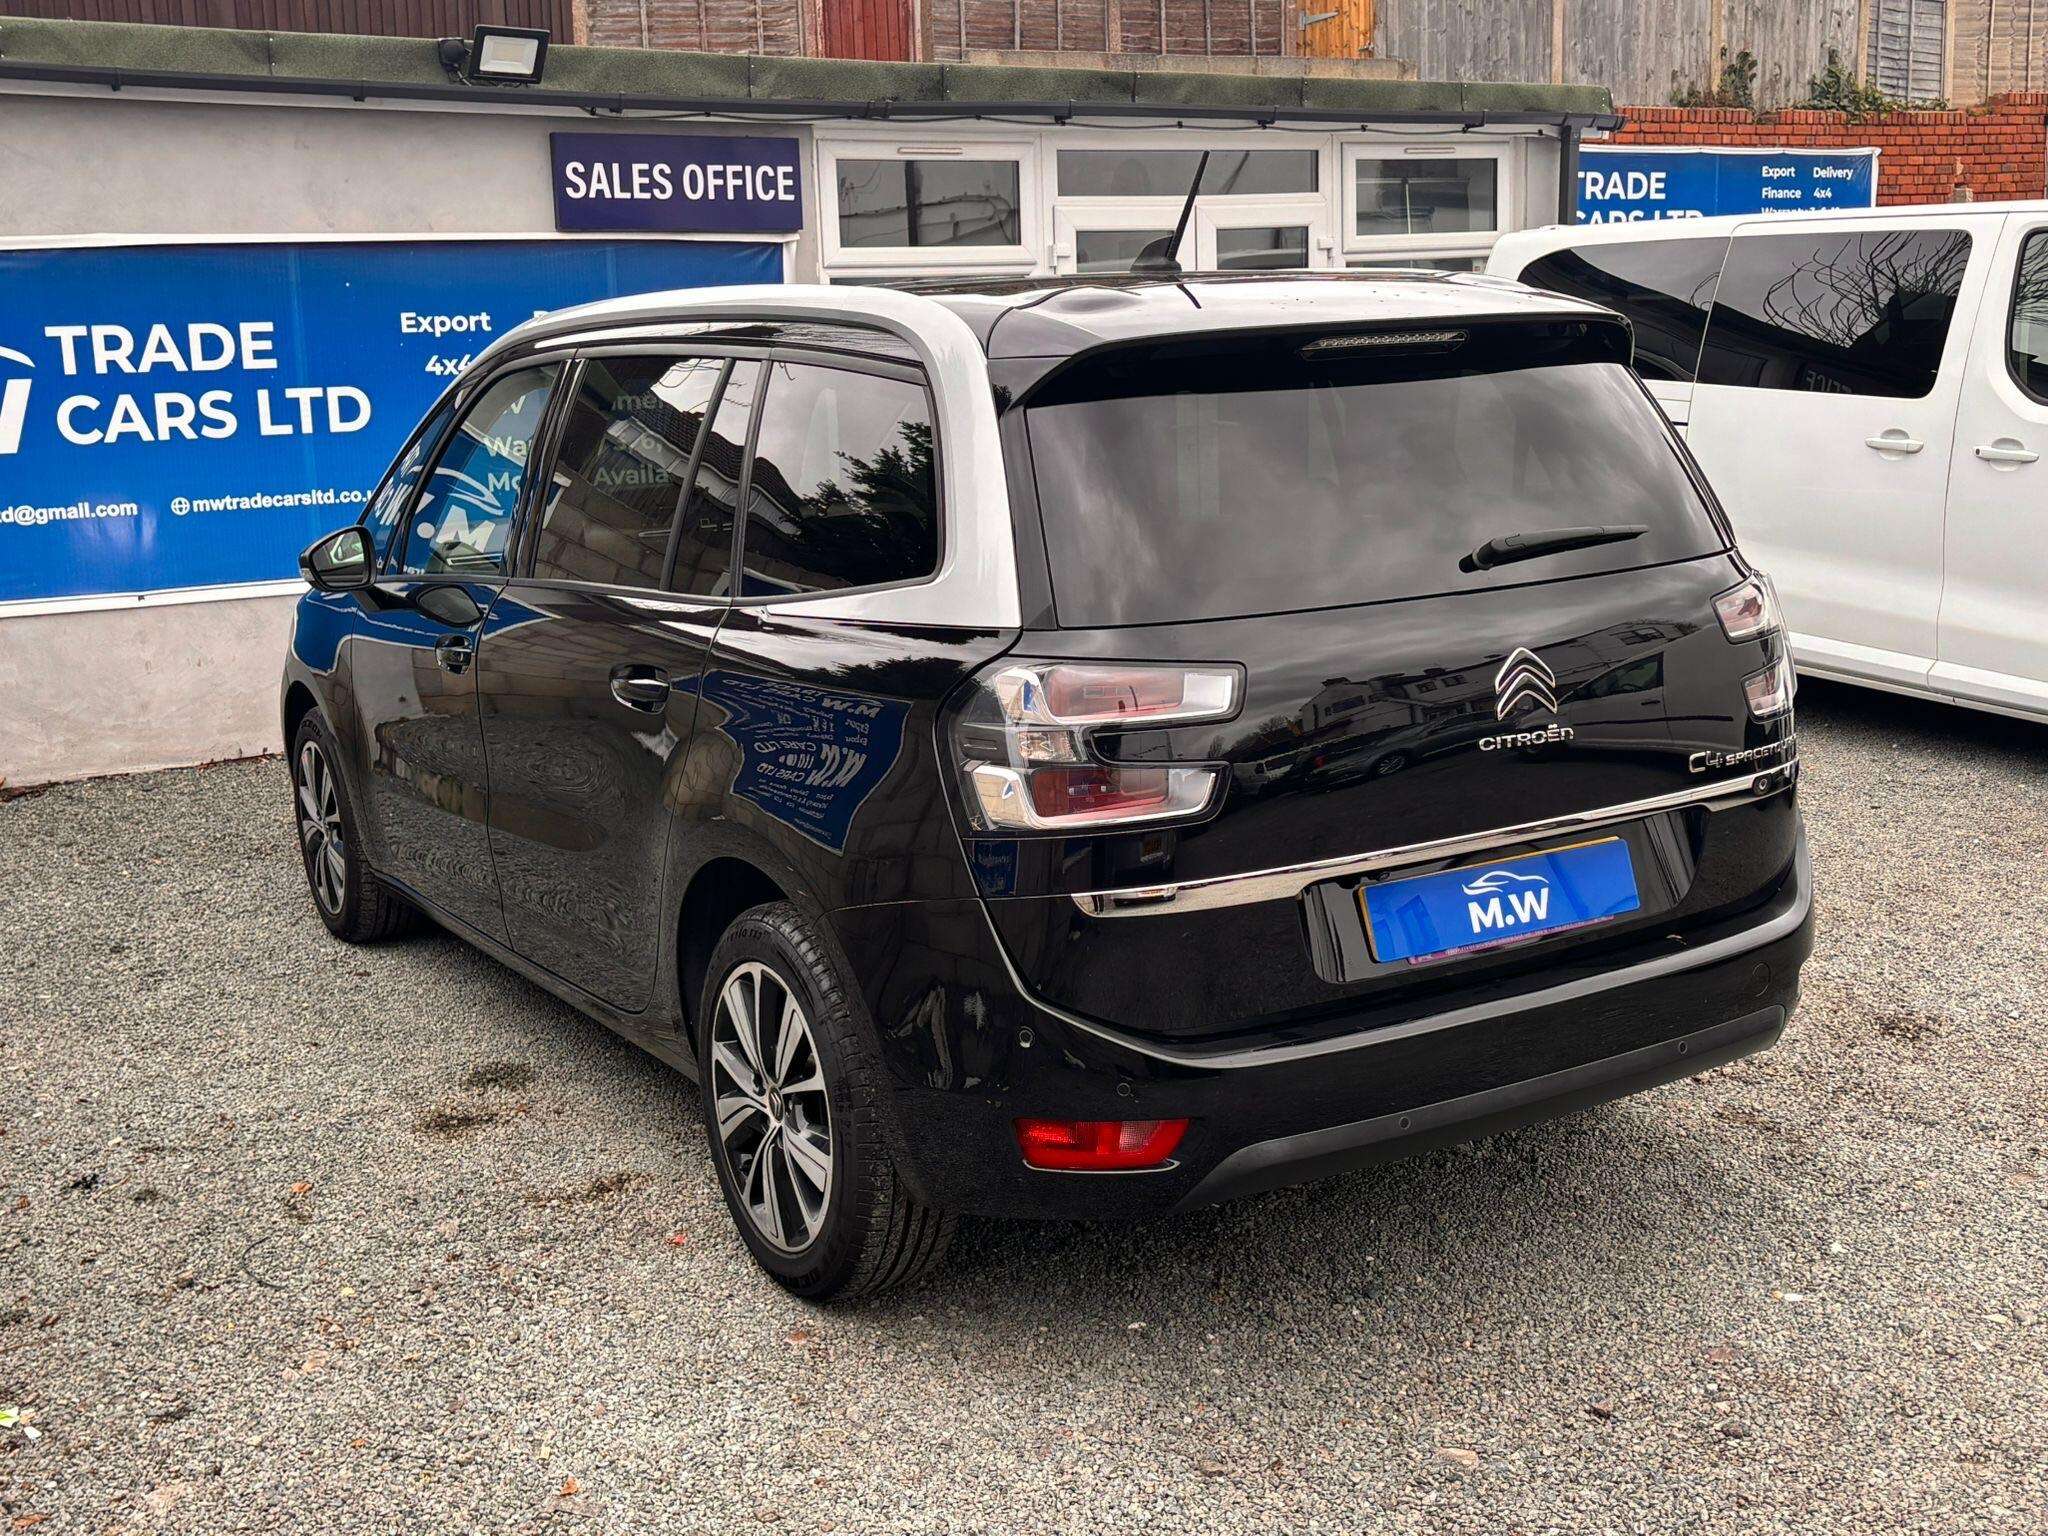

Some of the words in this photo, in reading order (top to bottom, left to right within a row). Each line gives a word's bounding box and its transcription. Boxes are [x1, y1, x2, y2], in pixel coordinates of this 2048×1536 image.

[565, 160, 673, 200] SALES
[682, 163, 796, 201] OFFICE
[1761, 165, 1796, 180] Export
[1812, 165, 1854, 180] Delivery
[1761, 186, 1802, 199] Finance
[1813, 187, 1833, 199] 4x4
[400, 311, 492, 338] Export
[44, 321, 278, 375] TRADE
[56, 389, 238, 445] CARS
[256, 386, 372, 436] LTD
[0, 502, 138, 526] d@gmail.com
[1479, 723, 1574, 751] CITROËN
[1688, 750, 1721, 773] C4
[1467, 886, 1549, 934] M.W
